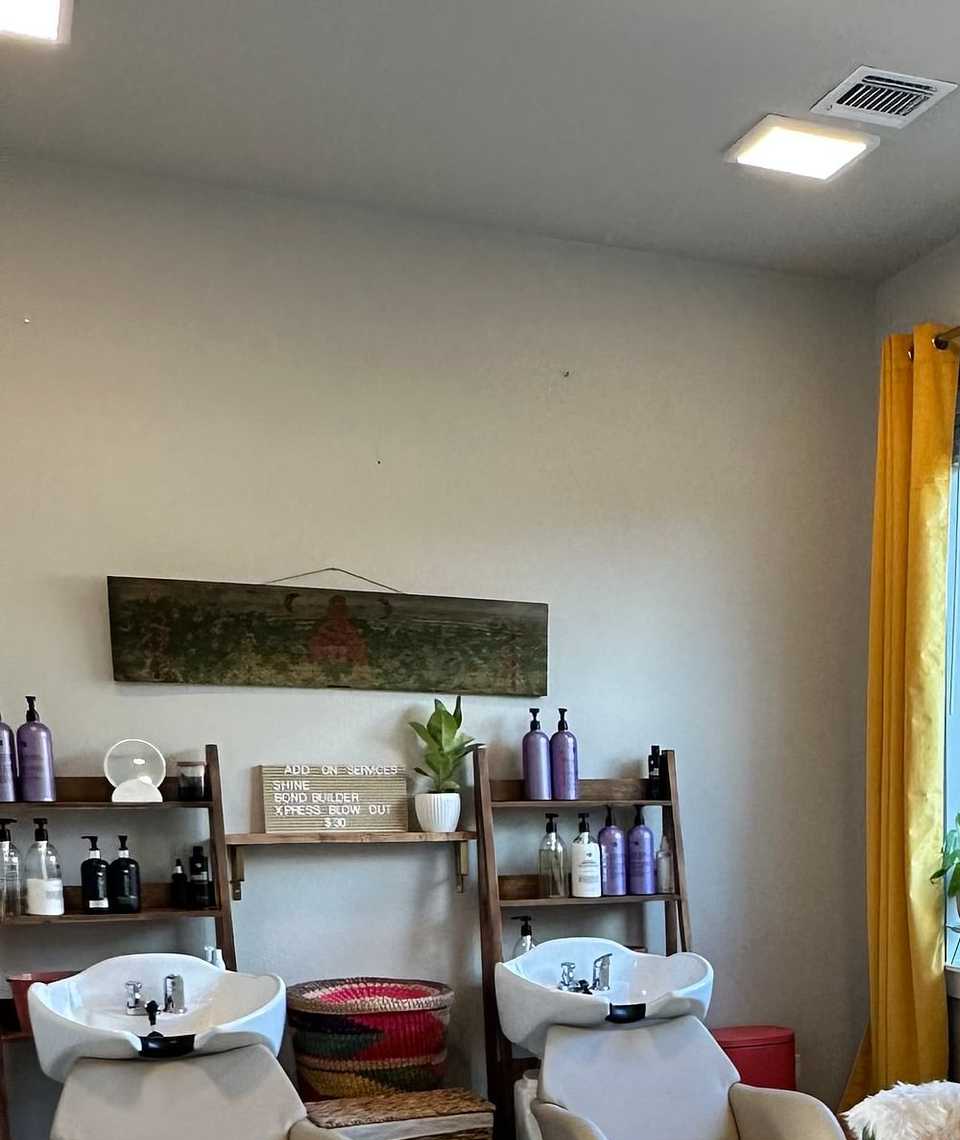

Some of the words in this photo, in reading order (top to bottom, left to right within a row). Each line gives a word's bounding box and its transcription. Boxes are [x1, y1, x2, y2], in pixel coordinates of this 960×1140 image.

[284, 765, 311, 775] ADD
[321, 765, 338, 775] ON
[348, 765, 398, 775] SERVICES
[272, 780, 310, 791] SHINE
[312, 792, 360, 803] BUILDER
[274, 804, 321, 815] XPRESS
[328, 804, 360, 815] BLOW
[369, 804, 391, 815] OUT
